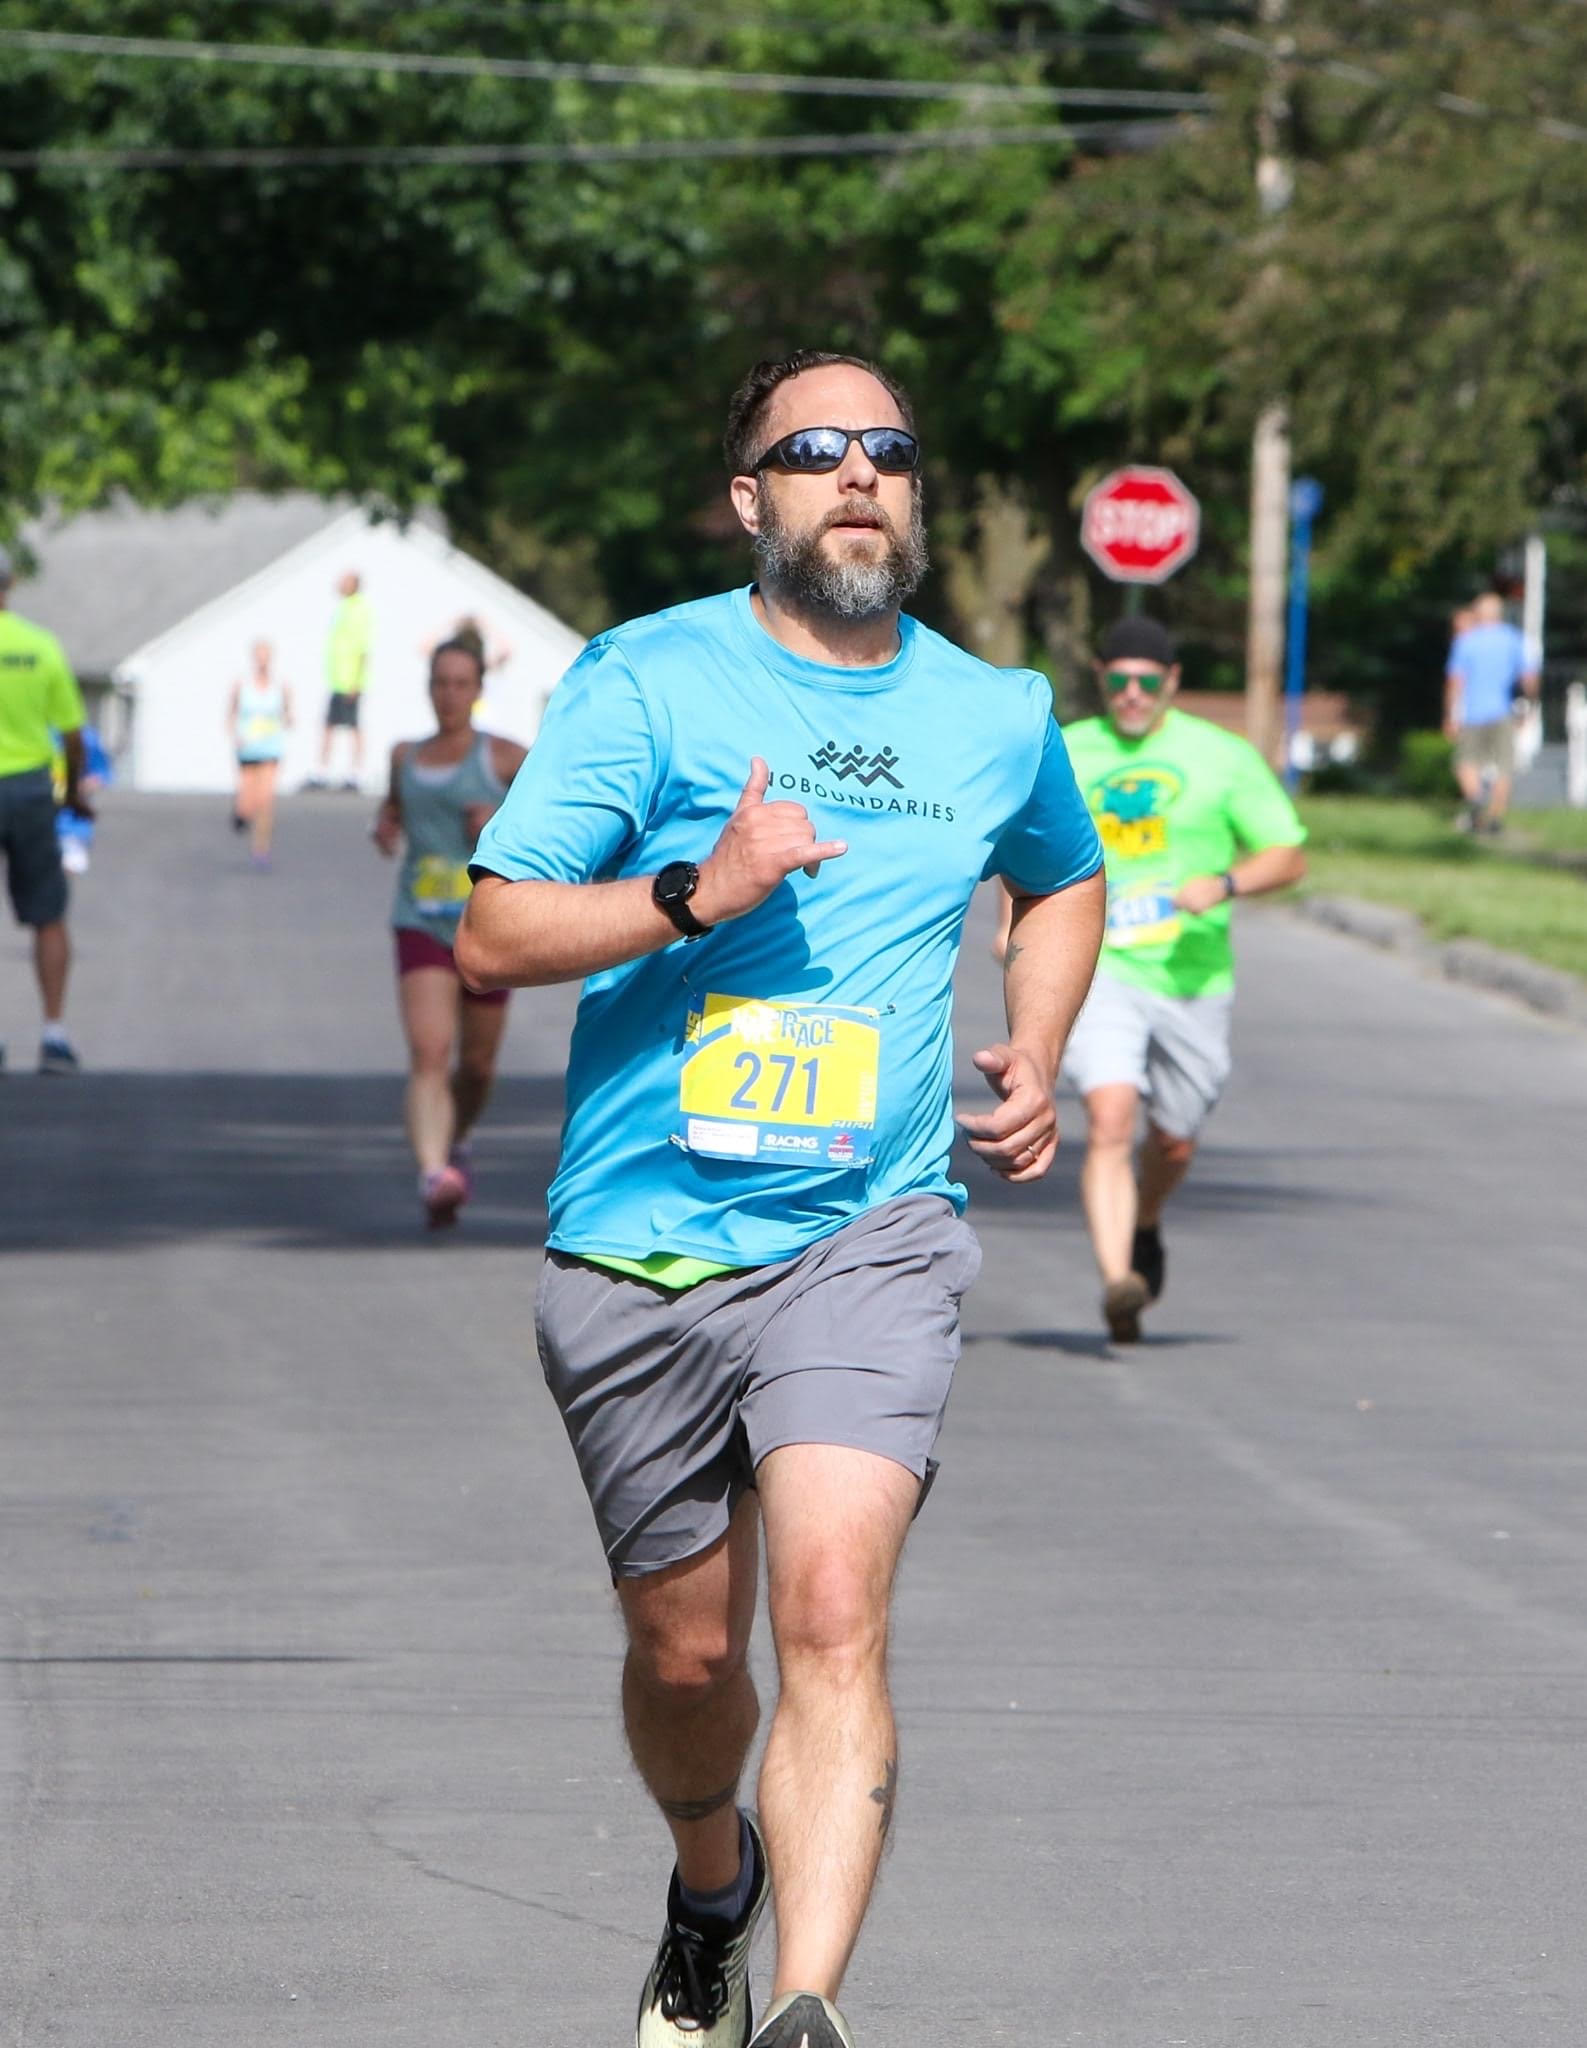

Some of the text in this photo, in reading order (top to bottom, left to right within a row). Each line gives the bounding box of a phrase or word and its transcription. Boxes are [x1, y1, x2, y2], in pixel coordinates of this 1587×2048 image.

[1090, 499, 1187, 549] STOP
[780, 1009, 836, 1048] RACE
[730, 1051, 819, 1115] 271
[764, 1133, 819, 1150] RACING
